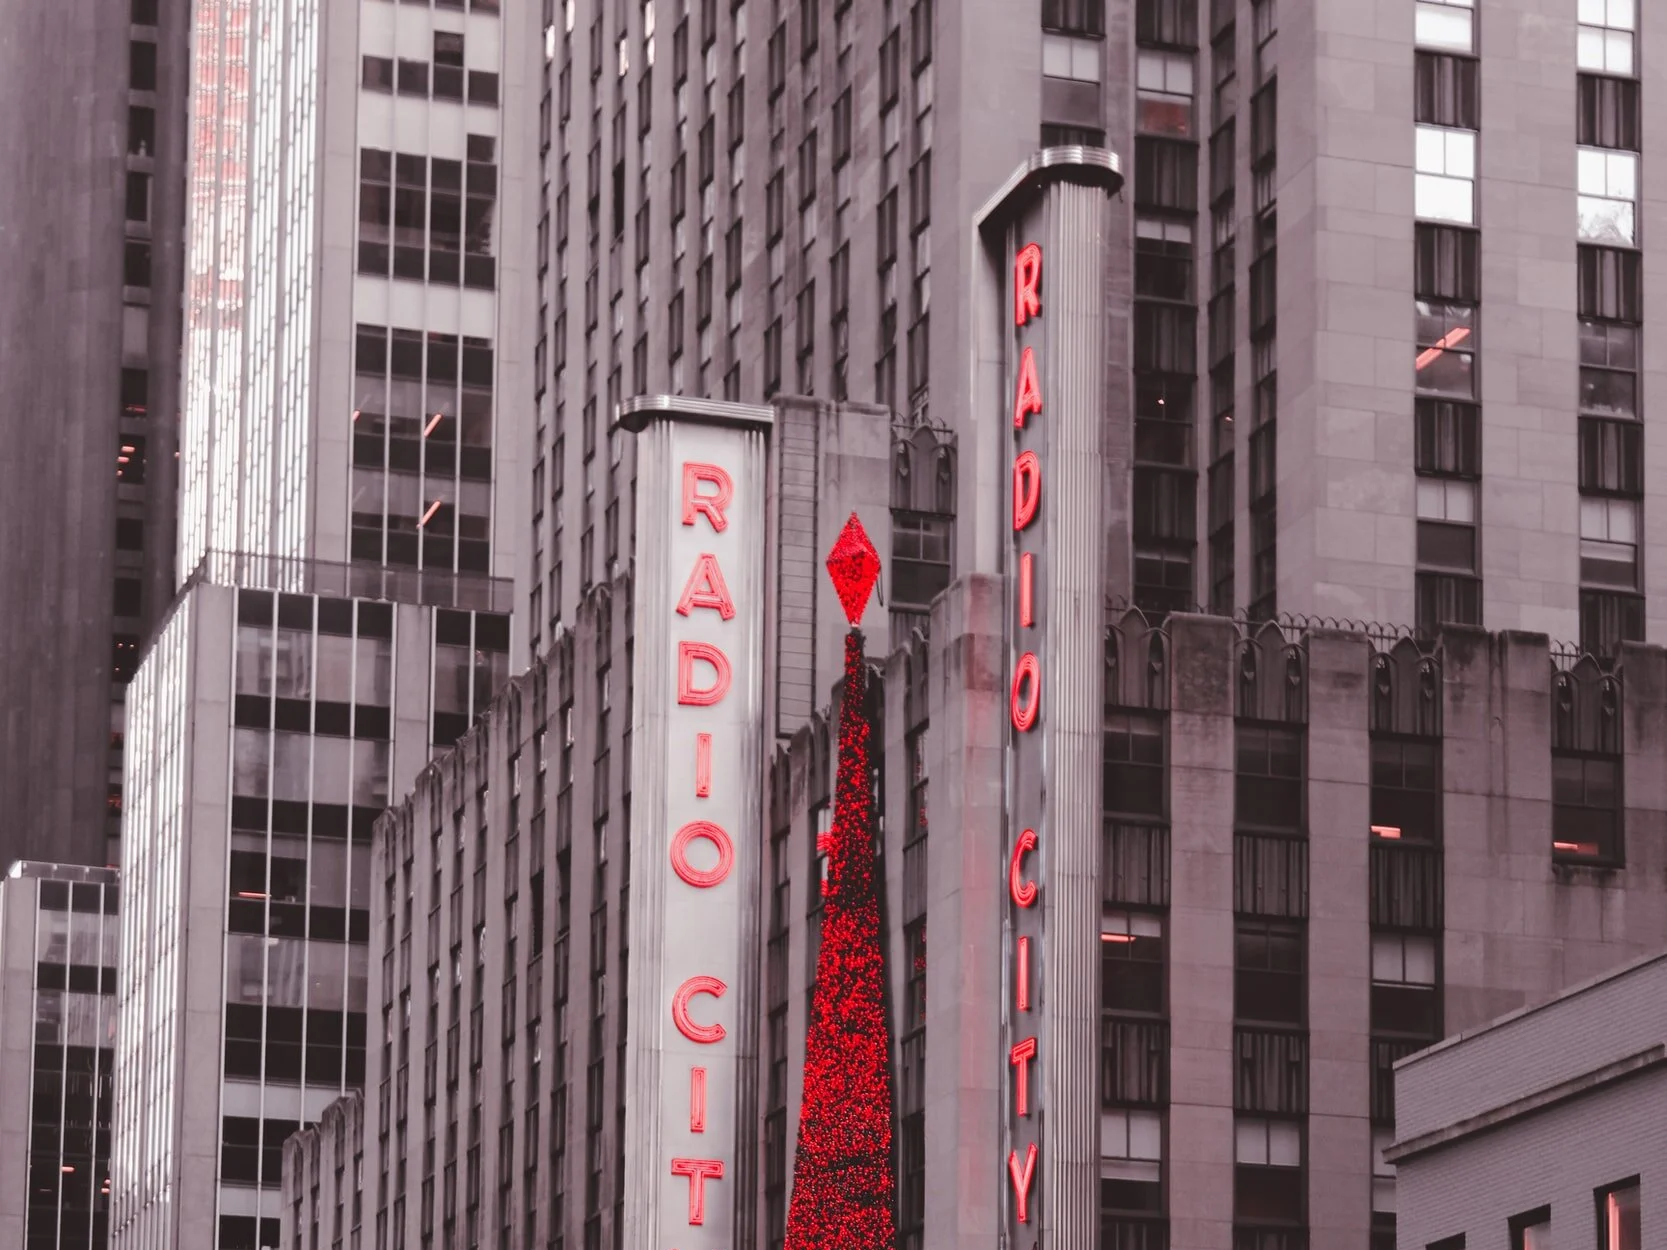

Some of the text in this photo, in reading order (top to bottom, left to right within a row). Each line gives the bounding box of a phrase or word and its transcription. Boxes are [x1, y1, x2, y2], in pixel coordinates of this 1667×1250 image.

[670, 461, 736, 888] RADIO
[1011, 241, 1042, 733] RADIO
[1009, 827, 1039, 1225] CITY
